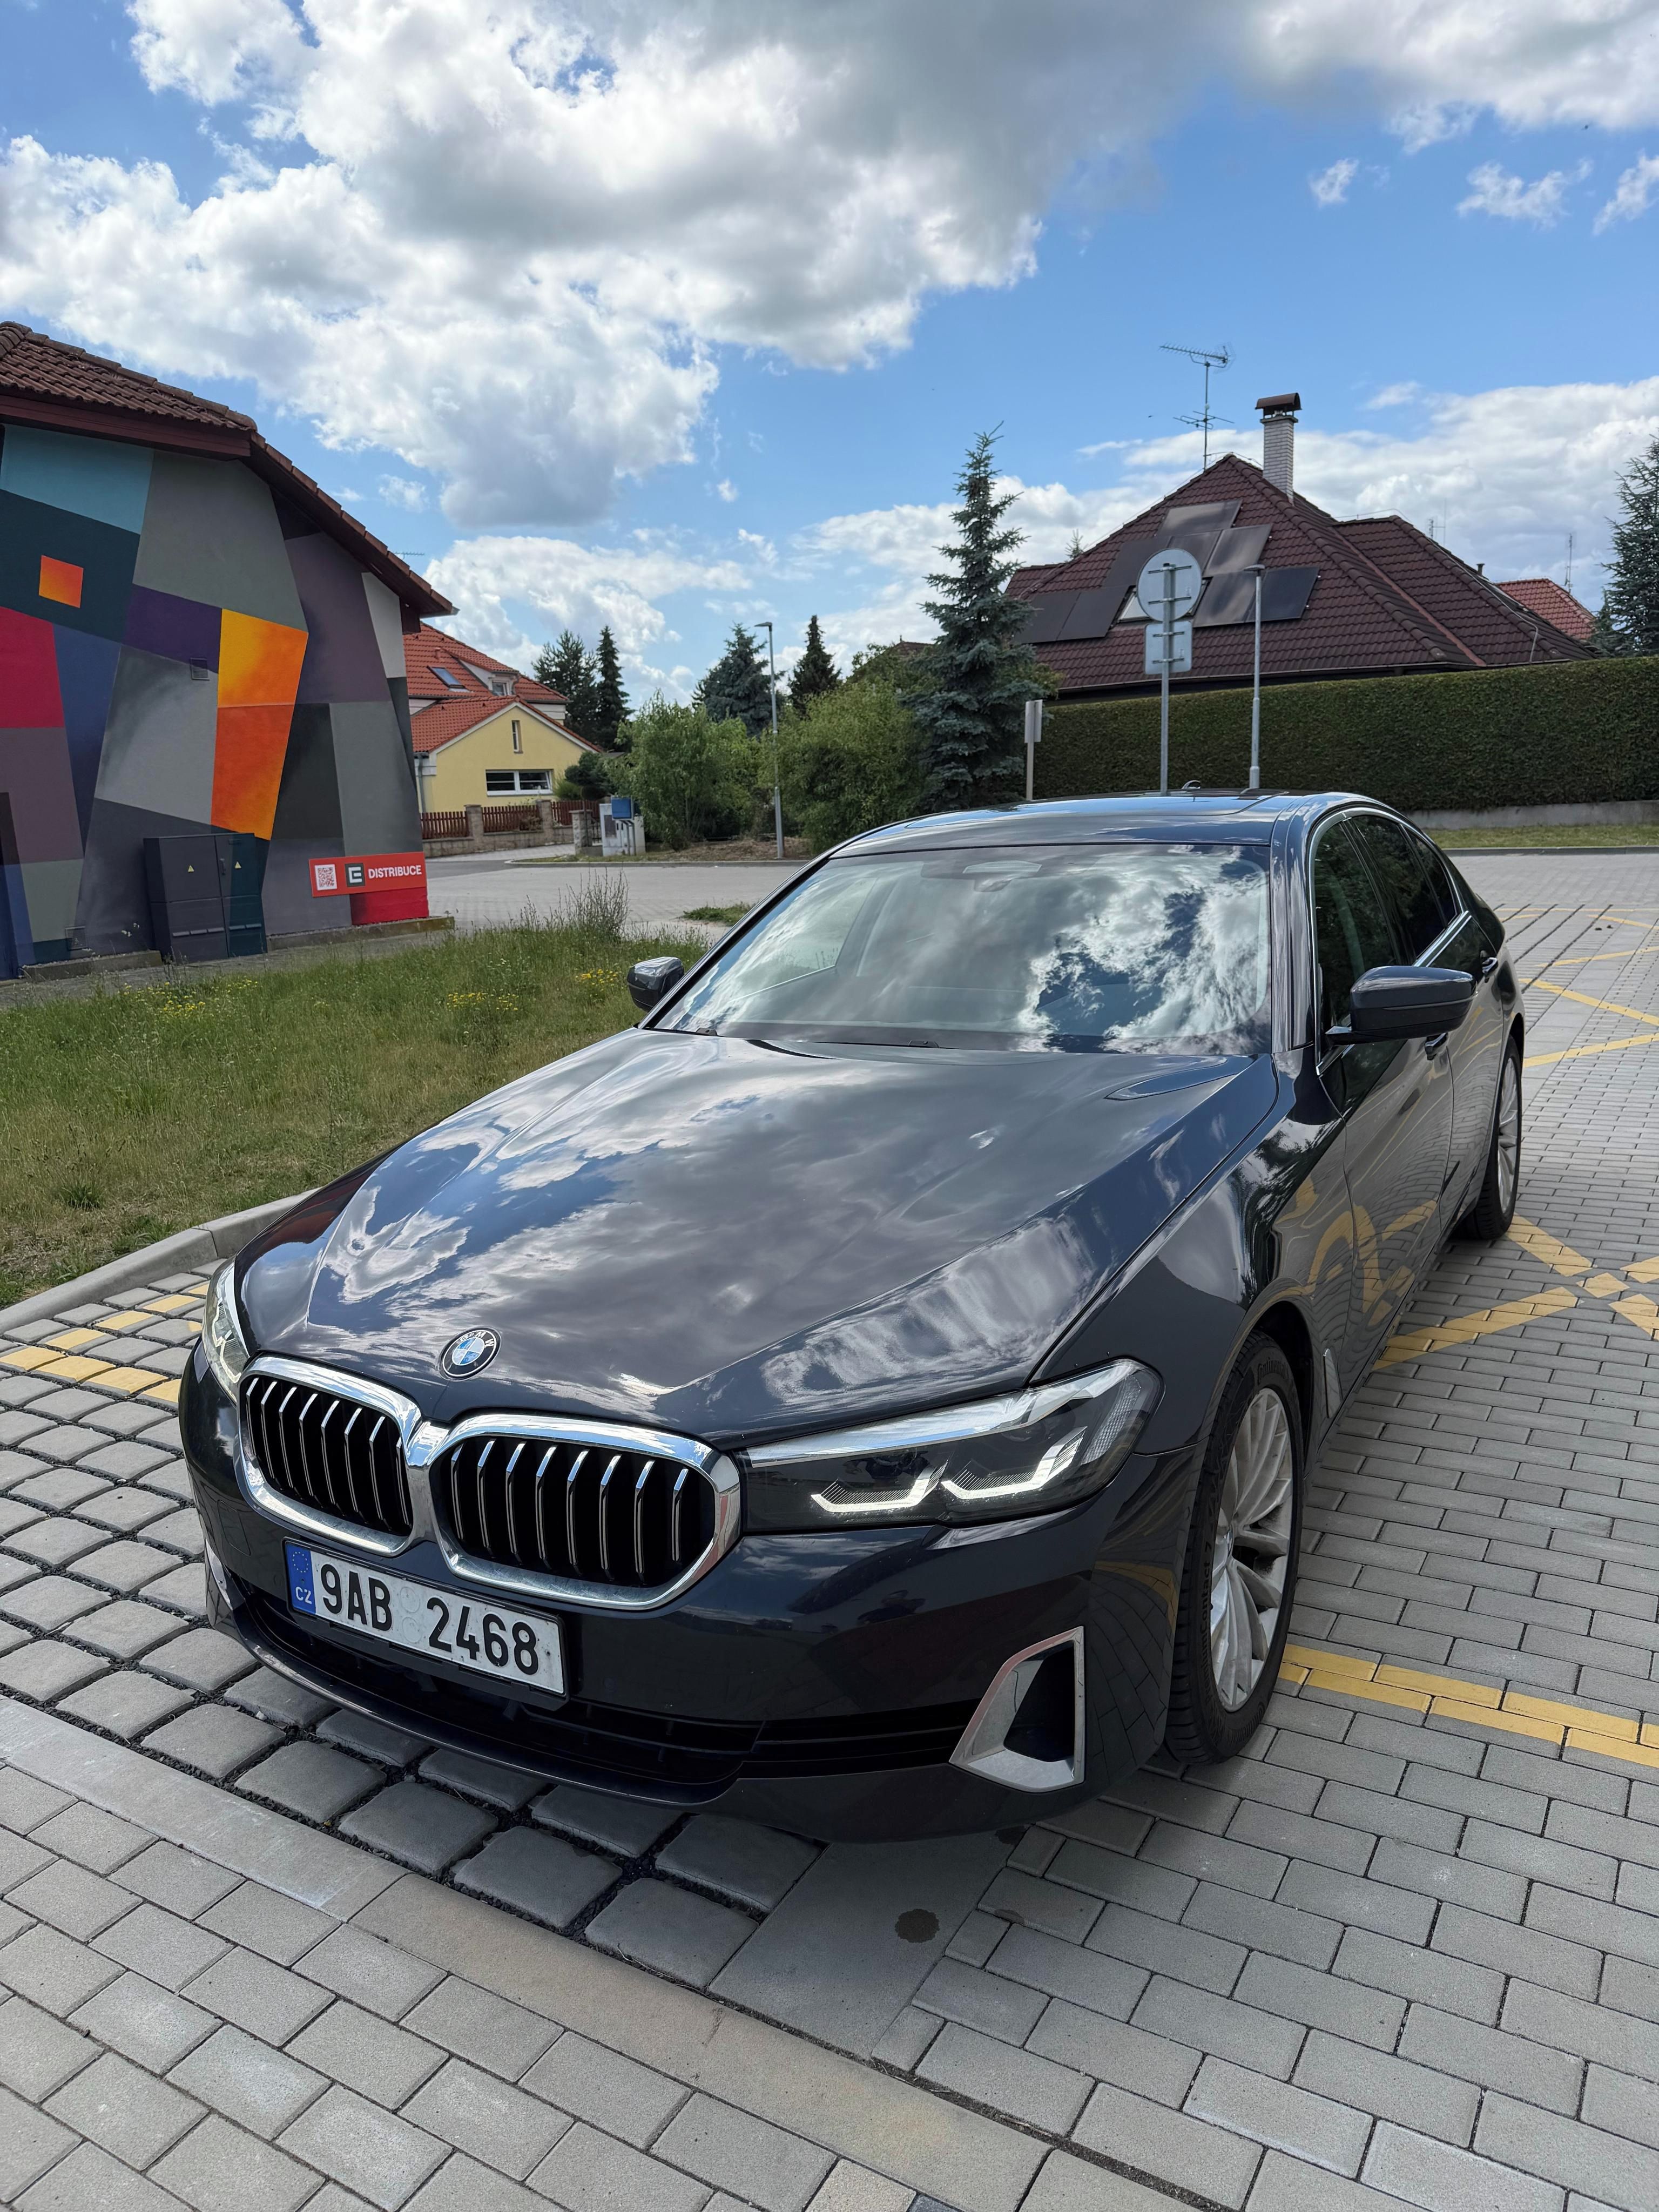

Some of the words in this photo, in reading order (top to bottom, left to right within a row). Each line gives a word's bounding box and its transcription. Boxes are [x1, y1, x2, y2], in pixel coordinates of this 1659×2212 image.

[368, 865, 422, 879] DISTRIBUCE
[459, 1331, 495, 1348] BMW
[295, 1586, 312, 1605] CZ
[320, 1563, 393, 1631] 9AB
[426, 1597, 539, 1675] 2468
